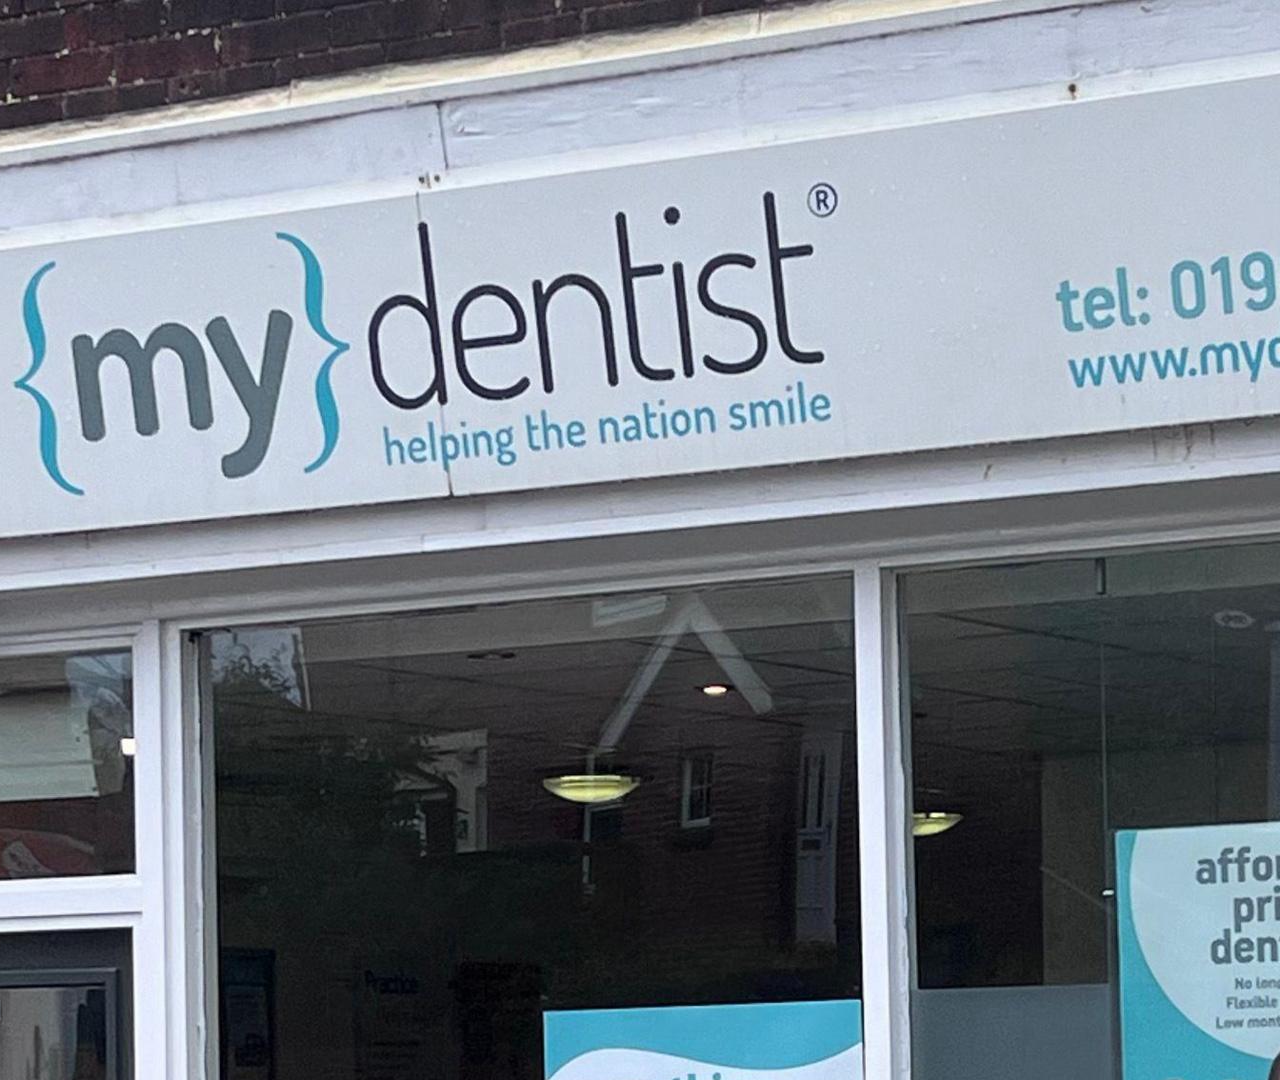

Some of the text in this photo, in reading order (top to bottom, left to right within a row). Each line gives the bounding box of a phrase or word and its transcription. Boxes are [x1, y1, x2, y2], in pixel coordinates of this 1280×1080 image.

[1055, 266, 1150, 333] tel:
[382, 381, 832, 473] helping the nation smile
[1234, 977, 1253, 990] No
[1226, 995, 1279, 1010] Flexible
[1215, 1017, 1245, 1031] Low
